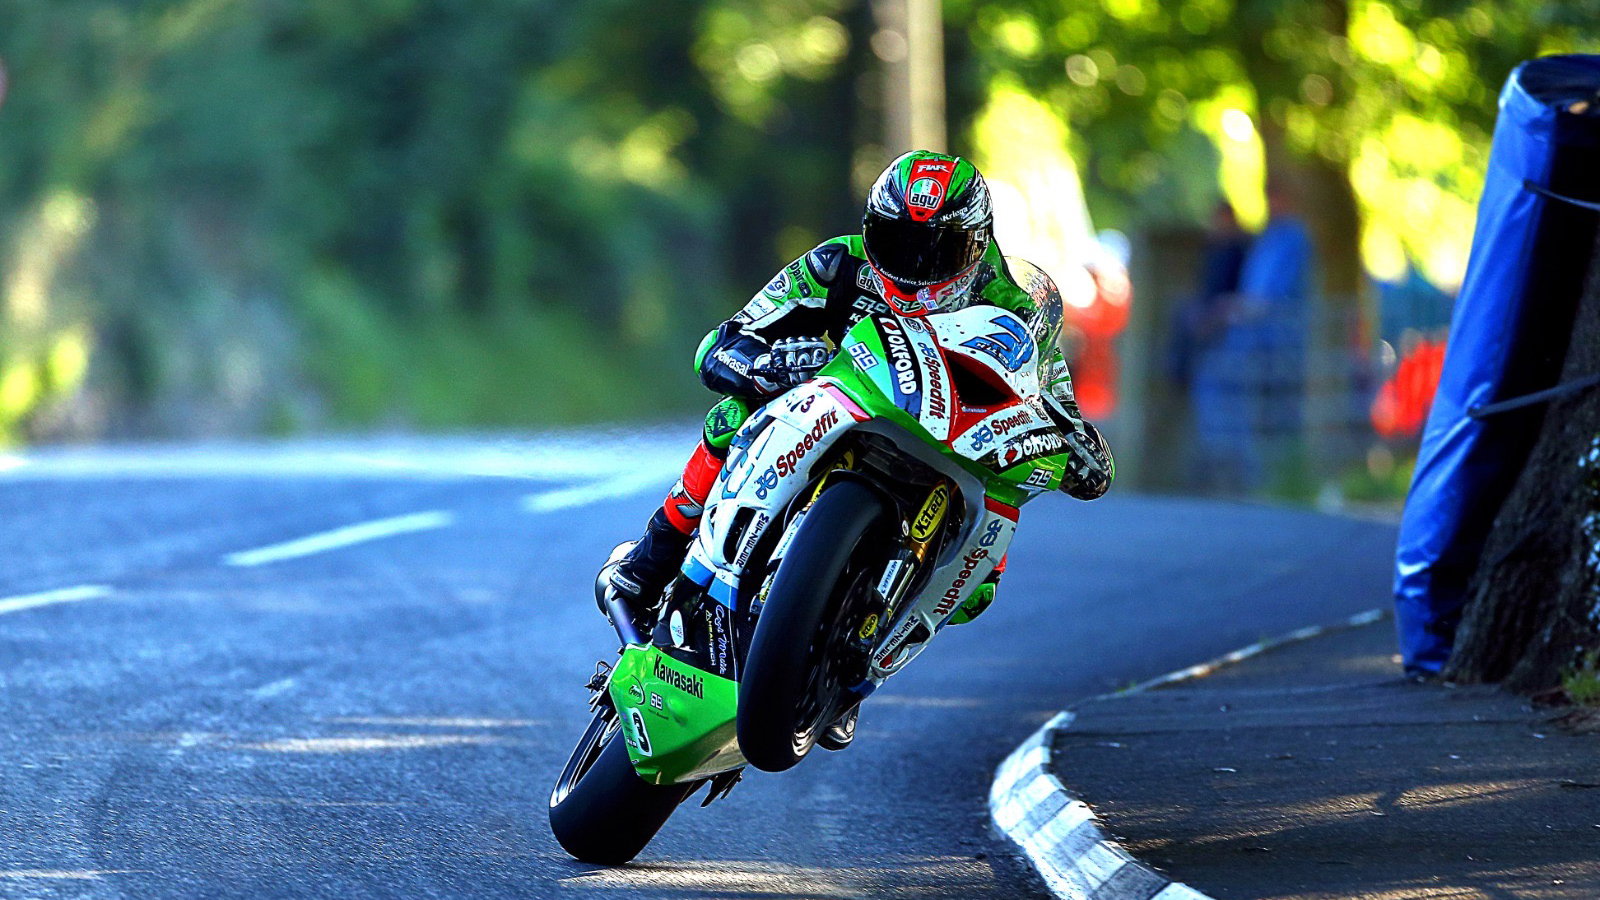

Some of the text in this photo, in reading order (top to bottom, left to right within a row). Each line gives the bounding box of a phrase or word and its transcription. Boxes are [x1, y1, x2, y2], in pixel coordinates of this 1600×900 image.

[911, 193, 938, 207] agv
[880, 267, 899, 281] Accident
[900, 277, 917, 285] Advice
[886, 335, 918, 395] OXFORD
[922, 356, 947, 420] Speedfit
[776, 409, 839, 477] Speedfit
[991, 410, 1033, 435] Speedfit
[1022, 433, 1062, 456] OXFORD
[735, 512, 770, 568] METZELER
[933, 547, 989, 616] Speedfit
[873, 615, 920, 662] METZELER
[653, 653, 704, 700] Kawasaki
